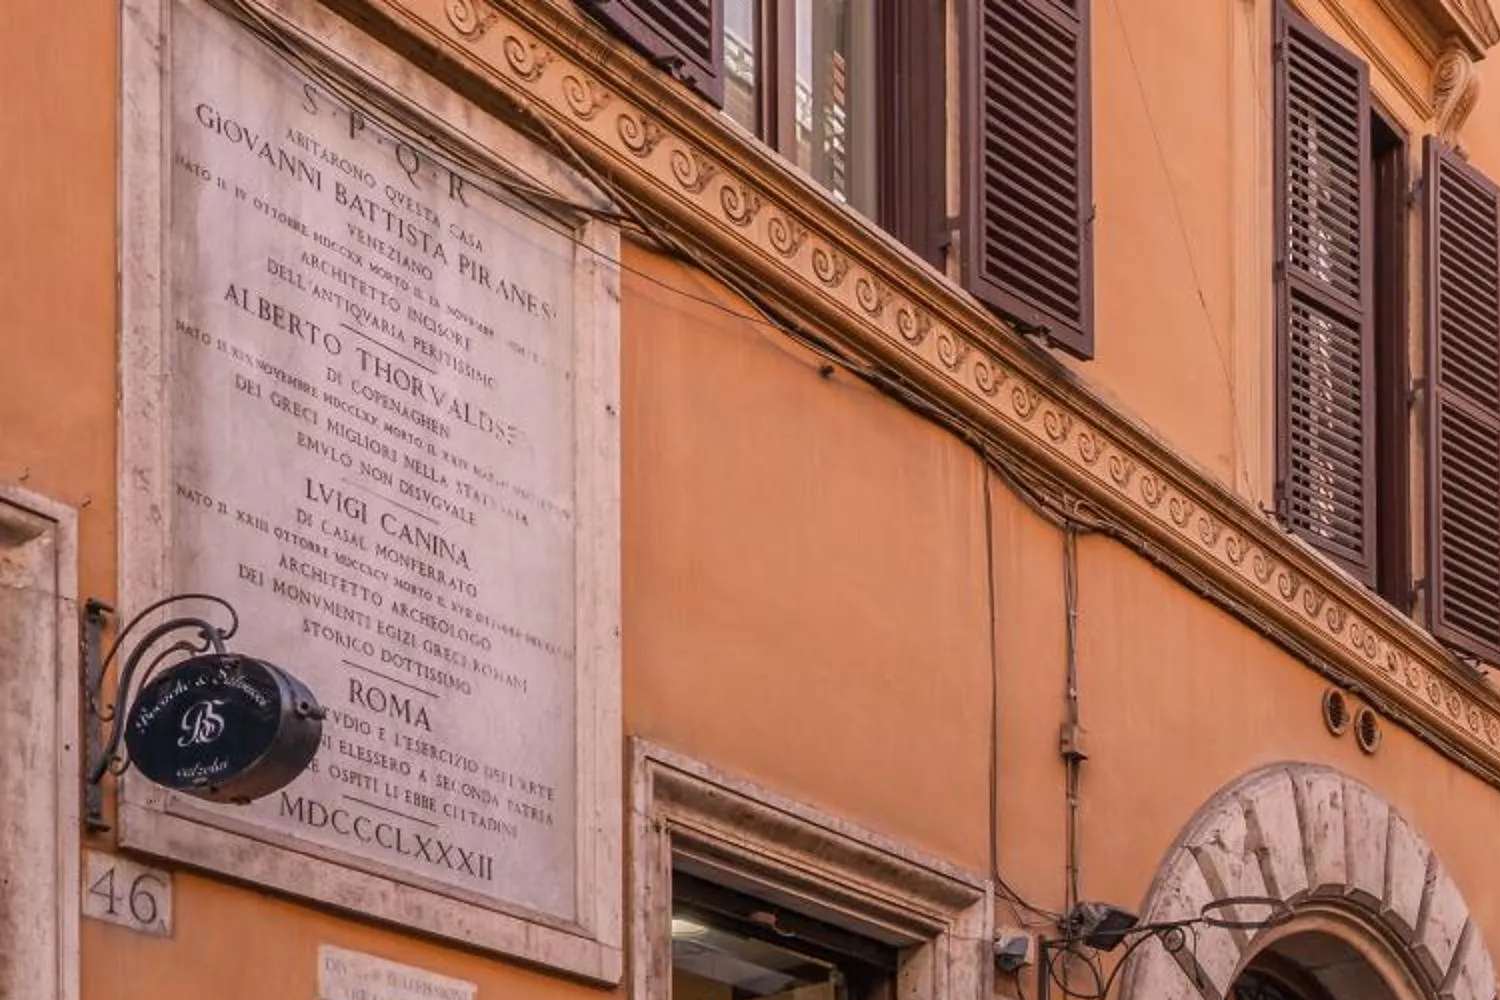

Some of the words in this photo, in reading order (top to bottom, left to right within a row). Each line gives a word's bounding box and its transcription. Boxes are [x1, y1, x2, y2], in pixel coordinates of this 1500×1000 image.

[194, 97, 321, 193] GIOVANNI
[334, 178, 448, 267] BATTISTA
[285, 122, 376, 191] ABITARONO
[448, 219, 483, 254] CASA
[300, 247, 400, 315] ARCHITETTO
[346, 219, 432, 284] VENEZIANO
[223, 276, 342, 360] ALBERTO
[235, 371, 261, 400] DEI
[270, 388, 318, 426] GRECI
[326, 415, 398, 465] MIGLIORI
[403, 452, 448, 489] NELLA
[326, 364, 342, 388] DI
[351, 376, 450, 442] COPENAGHEN
[175, 481, 211, 511] NATO
[296, 428, 352, 470] EMVLO
[359, 457, 393, 488] NON
[296, 505, 313, 529] DI
[320, 516, 368, 553] CASAL
[374, 540, 477, 600] MONFERRATO
[305, 474, 367, 526] LVIGI
[379, 508, 470, 572] CANINA
[238, 561, 263, 589] DEI
[271, 575, 370, 631] MONVMENTI
[376, 618, 416, 649] EGIZI
[422, 637, 467, 670] GRECI
[278, 549, 383, 608] ARCHITETTO
[391, 597, 492, 653] ARCHEOLOGO
[302, 616, 375, 659] STORICO
[380, 645, 472, 697] DOTTISSIMO
[348, 675, 432, 733] ROMA
[377, 723, 385, 742] E
[328, 761, 377, 794] OSPITI
[385, 781, 398, 801] LI
[404, 787, 437, 814] EBBE
[339, 738, 411, 778] ELESSERO
[418, 766, 427, 784] A
[435, 771, 499, 809] SECONDA
[506, 797, 554, 828] PATRIA
[279, 788, 494, 882] MDCCCLXXXII
[89, 867, 166, 925] 46
